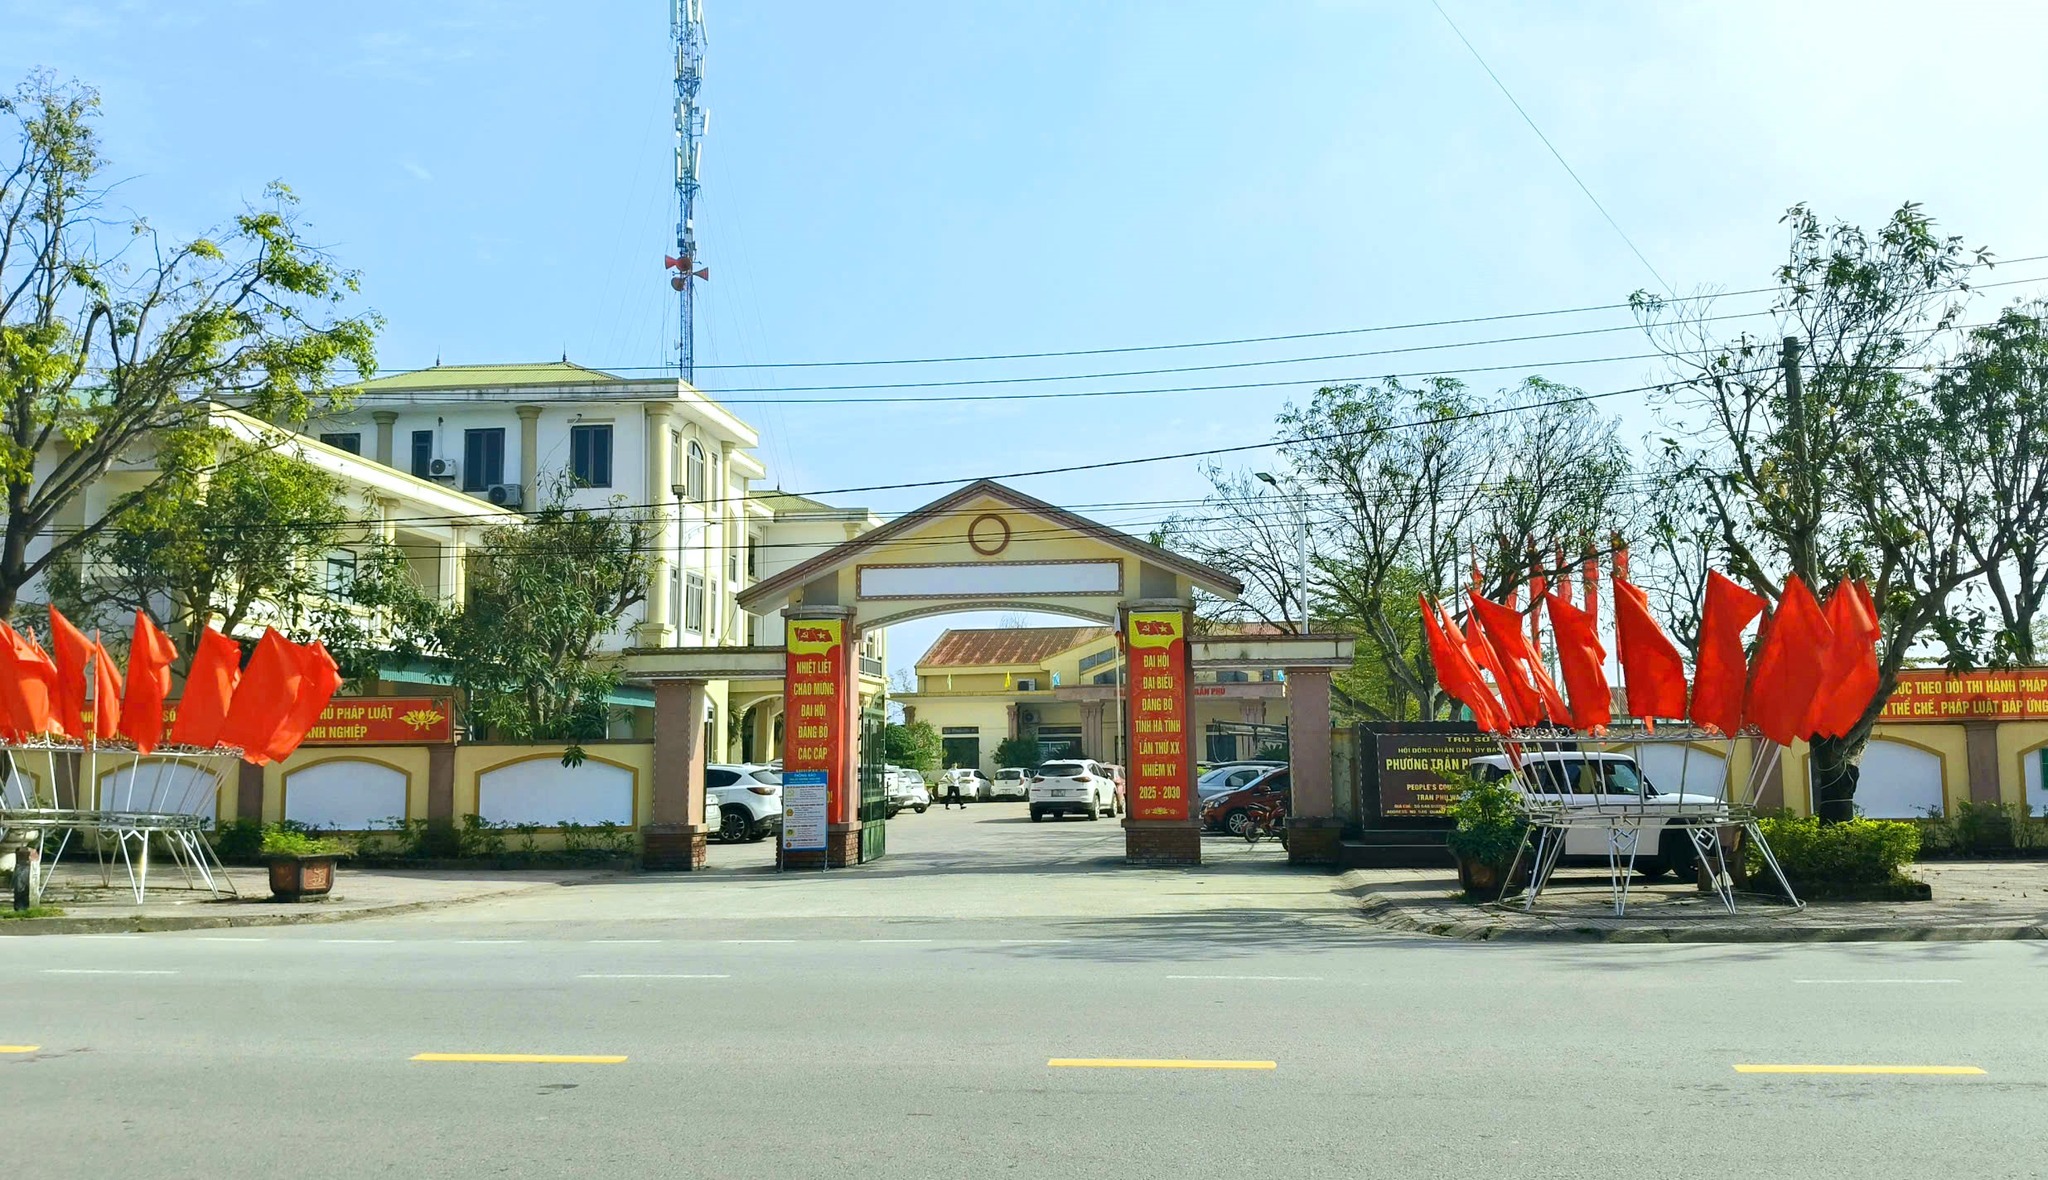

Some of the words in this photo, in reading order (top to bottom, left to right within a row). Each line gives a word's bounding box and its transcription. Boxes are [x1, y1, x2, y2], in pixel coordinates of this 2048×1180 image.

[796, 659, 816, 677] NHIỆT
[818, 659, 832, 677] LIỆT
[1143, 654, 1156, 671] ĐẠI
[1157, 652, 1170, 671] HỘI
[793, 680, 813, 696] CHÀO
[813, 680, 835, 696] MỪNG
[1143, 676, 1155, 692] ĐẠI
[1156, 671, 1173, 690] BIỂU
[1914, 681, 1942, 695] THEO
[1945, 678, 1963, 694] DÕI
[1966, 680, 1983, 693] THI
[1986, 677, 2016, 693] HÀNH
[2019, 676, 2047, 692] PHÁP
[801, 704, 813, 720] ĐẠI
[814, 702, 827, 720] HỘI
[1141, 693, 1162, 711] ĐẢNG
[1163, 695, 1173, 714] BỘ
[1890, 697, 1911, 715] THỂ
[1913, 698, 1938, 716] CHẾ,
[1940, 699, 1969, 715] PHÁP
[1973, 697, 1999, 716] LUẬT
[2002, 697, 2023, 713] ĐÁP
[2026, 697, 2048, 713] ỨNG
[319, 704, 334, 720] HỦ
[336, 704, 365, 720] PHÁP
[367, 704, 394, 722] LUẬT
[305, 726, 326, 738] ANH
[329, 723, 368, 741] NGHIỆP
[798, 721, 818, 739] ĐẢNG
[818, 722, 829, 741] BỘ
[1135, 715, 1152, 733] TỈNH
[1152, 716, 1163, 733] HÀ
[1164, 717, 1181, 733] TĨNH
[1154, 739, 1169, 755] THỨ
[1170, 741, 1181, 755] XX
[1446, 736, 1470, 744] TRỤ
[1473, 735, 1491, 743] SỞ
[797, 744, 812, 760] CÁC
[813, 742, 828, 760] CẤP
[1142, 761, 1166, 780] NHIỆM
[1386, 755, 1429, 771] PHƯỜNG
[1430, 754, 1460, 772] TRẦN
[1139, 786, 1157, 799] 2025
[1163, 786, 1181, 799] 2030
